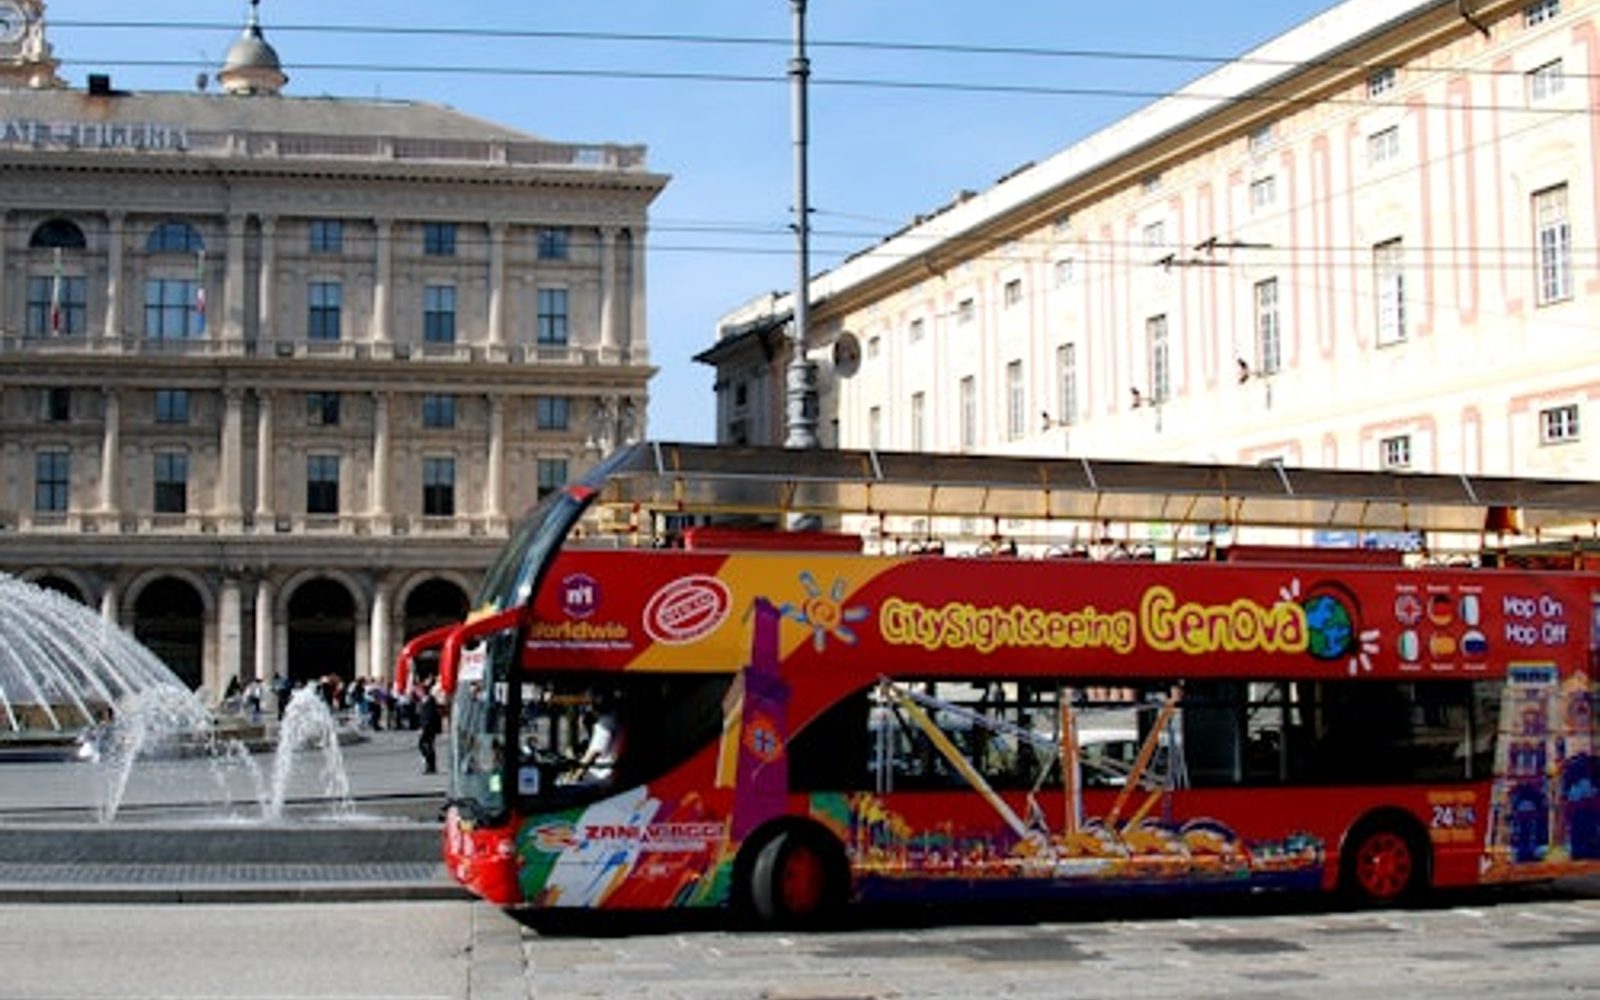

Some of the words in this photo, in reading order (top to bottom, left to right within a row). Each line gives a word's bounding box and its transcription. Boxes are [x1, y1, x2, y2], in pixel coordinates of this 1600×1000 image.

[1503, 596, 1536, 618] Hop
[1539, 596, 1563, 618] On
[880, 598, 1137, 653] CitySightseeing
[1141, 585, 1307, 653] Genova
[1506, 623, 1538, 645] Hop
[1541, 623, 1568, 643] Off
